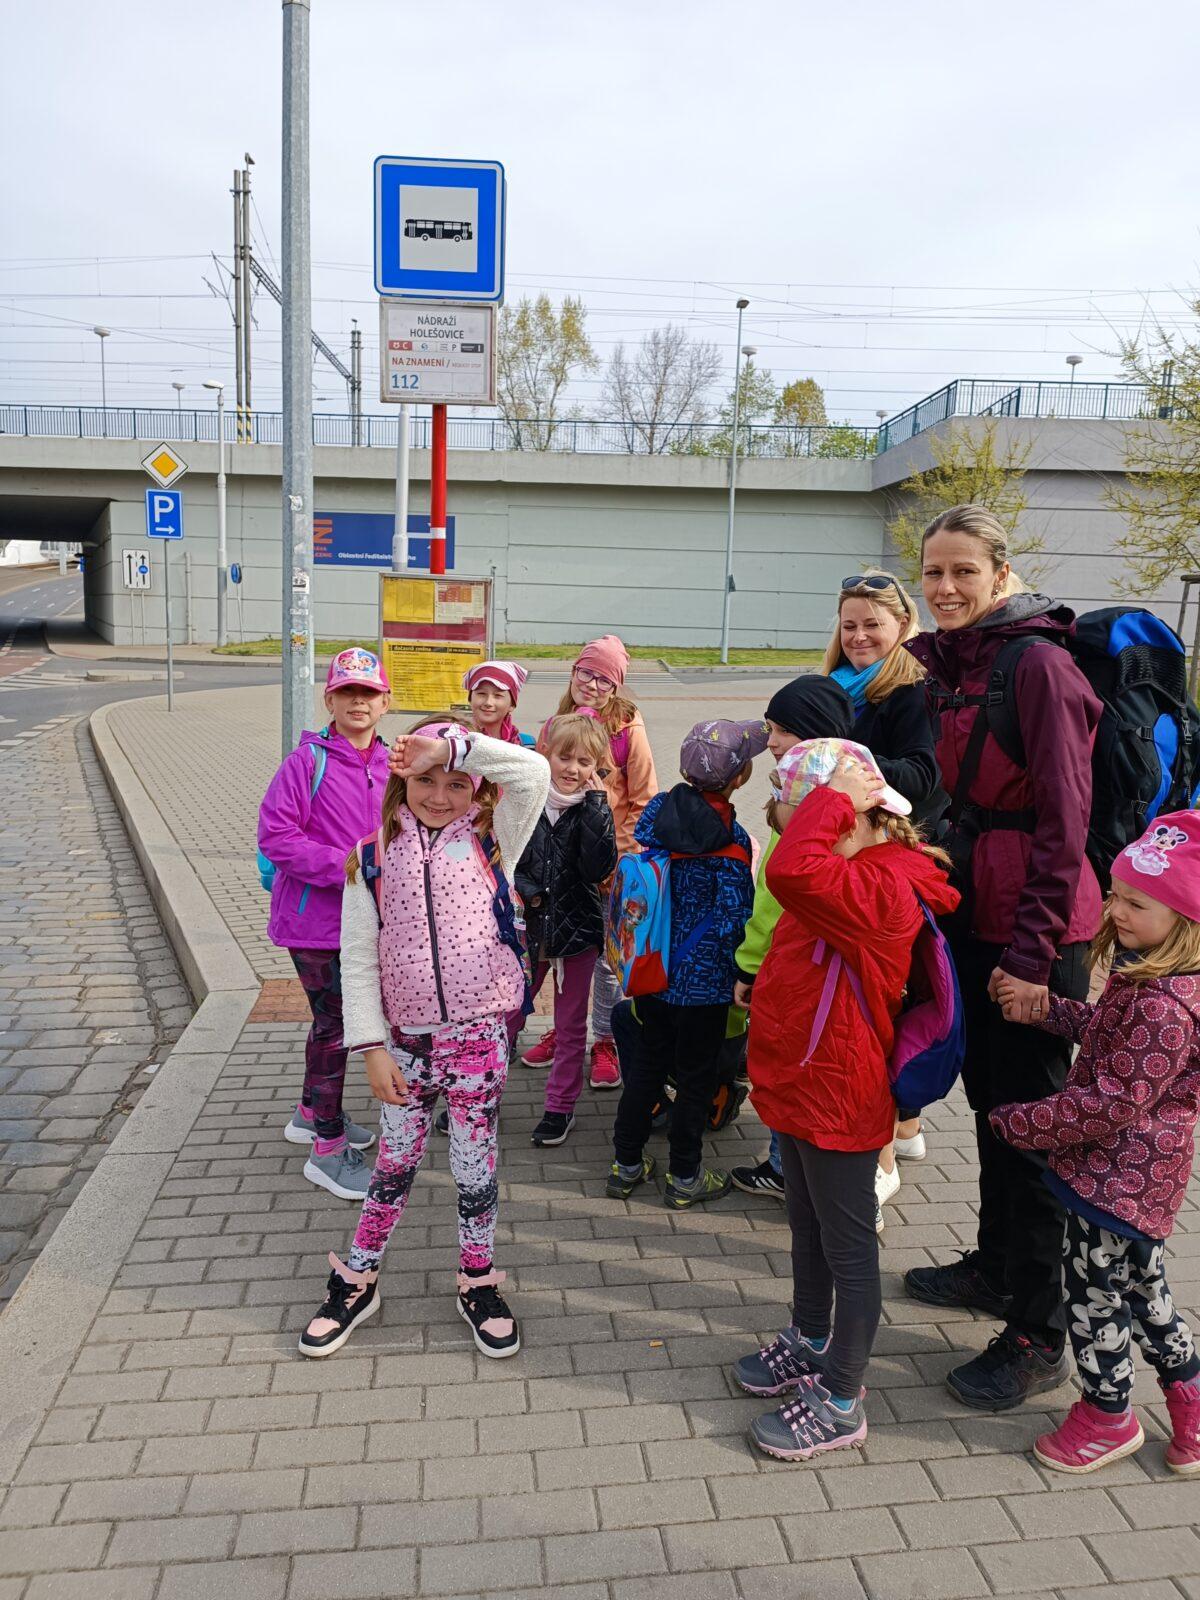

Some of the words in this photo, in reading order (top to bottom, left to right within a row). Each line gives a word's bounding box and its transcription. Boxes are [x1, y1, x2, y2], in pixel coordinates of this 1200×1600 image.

[417, 315, 457, 326] NÁDRAŽÍ
[410, 328, 465, 339] HOLEŠOVICE
[392, 357, 404, 366] NA
[405, 357, 444, 367] ZNAMENÍ
[392, 374, 419, 389] 112
[153, 495, 175, 523] P
